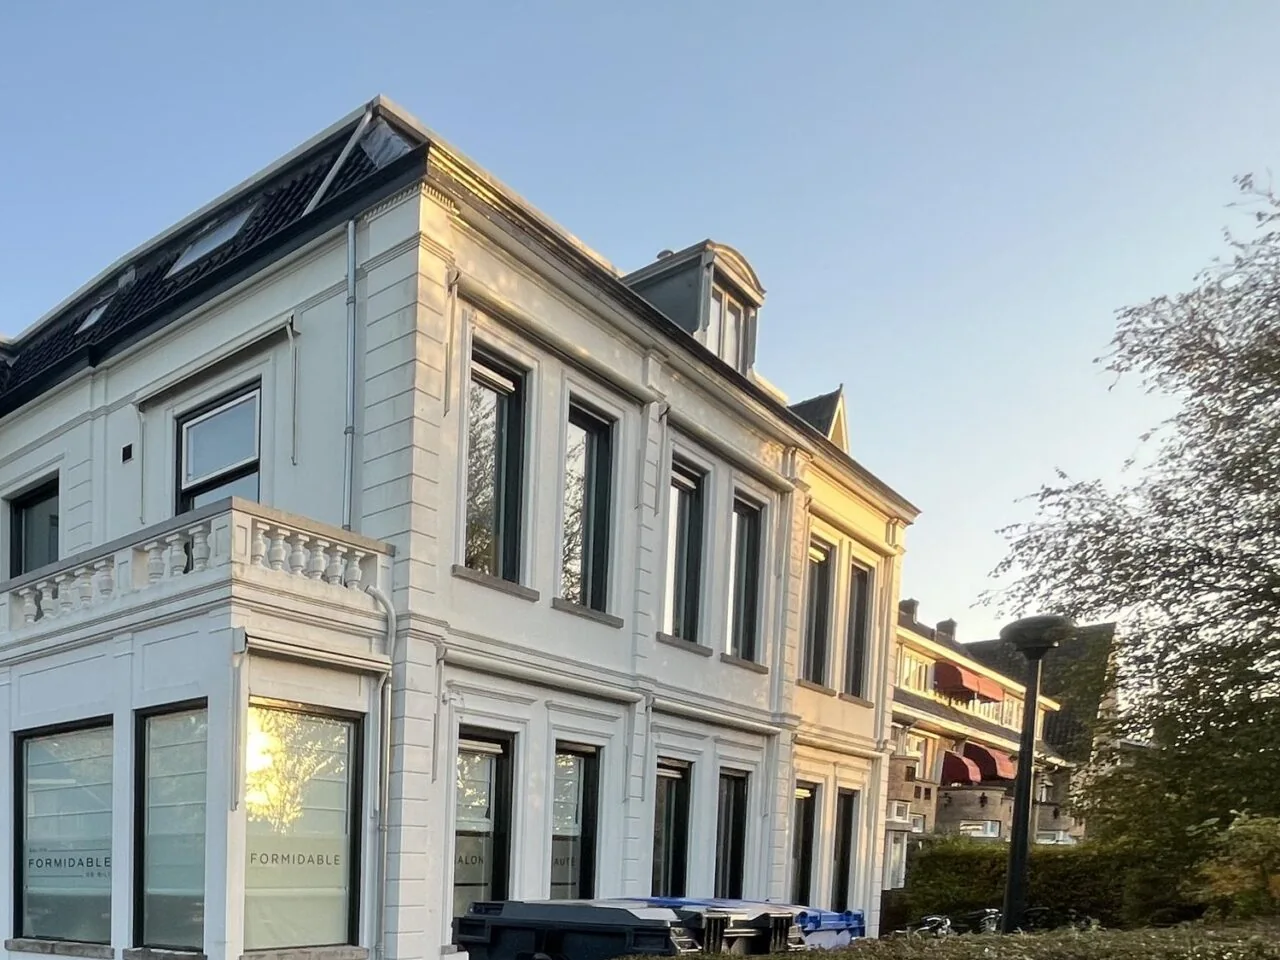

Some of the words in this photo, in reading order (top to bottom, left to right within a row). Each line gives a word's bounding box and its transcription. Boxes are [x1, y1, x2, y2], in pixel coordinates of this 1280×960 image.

[28, 857, 111, 868] FORMIDABLE
[249, 852, 341, 865] FORMIDABLE
[456, 855, 484, 865] ALON
